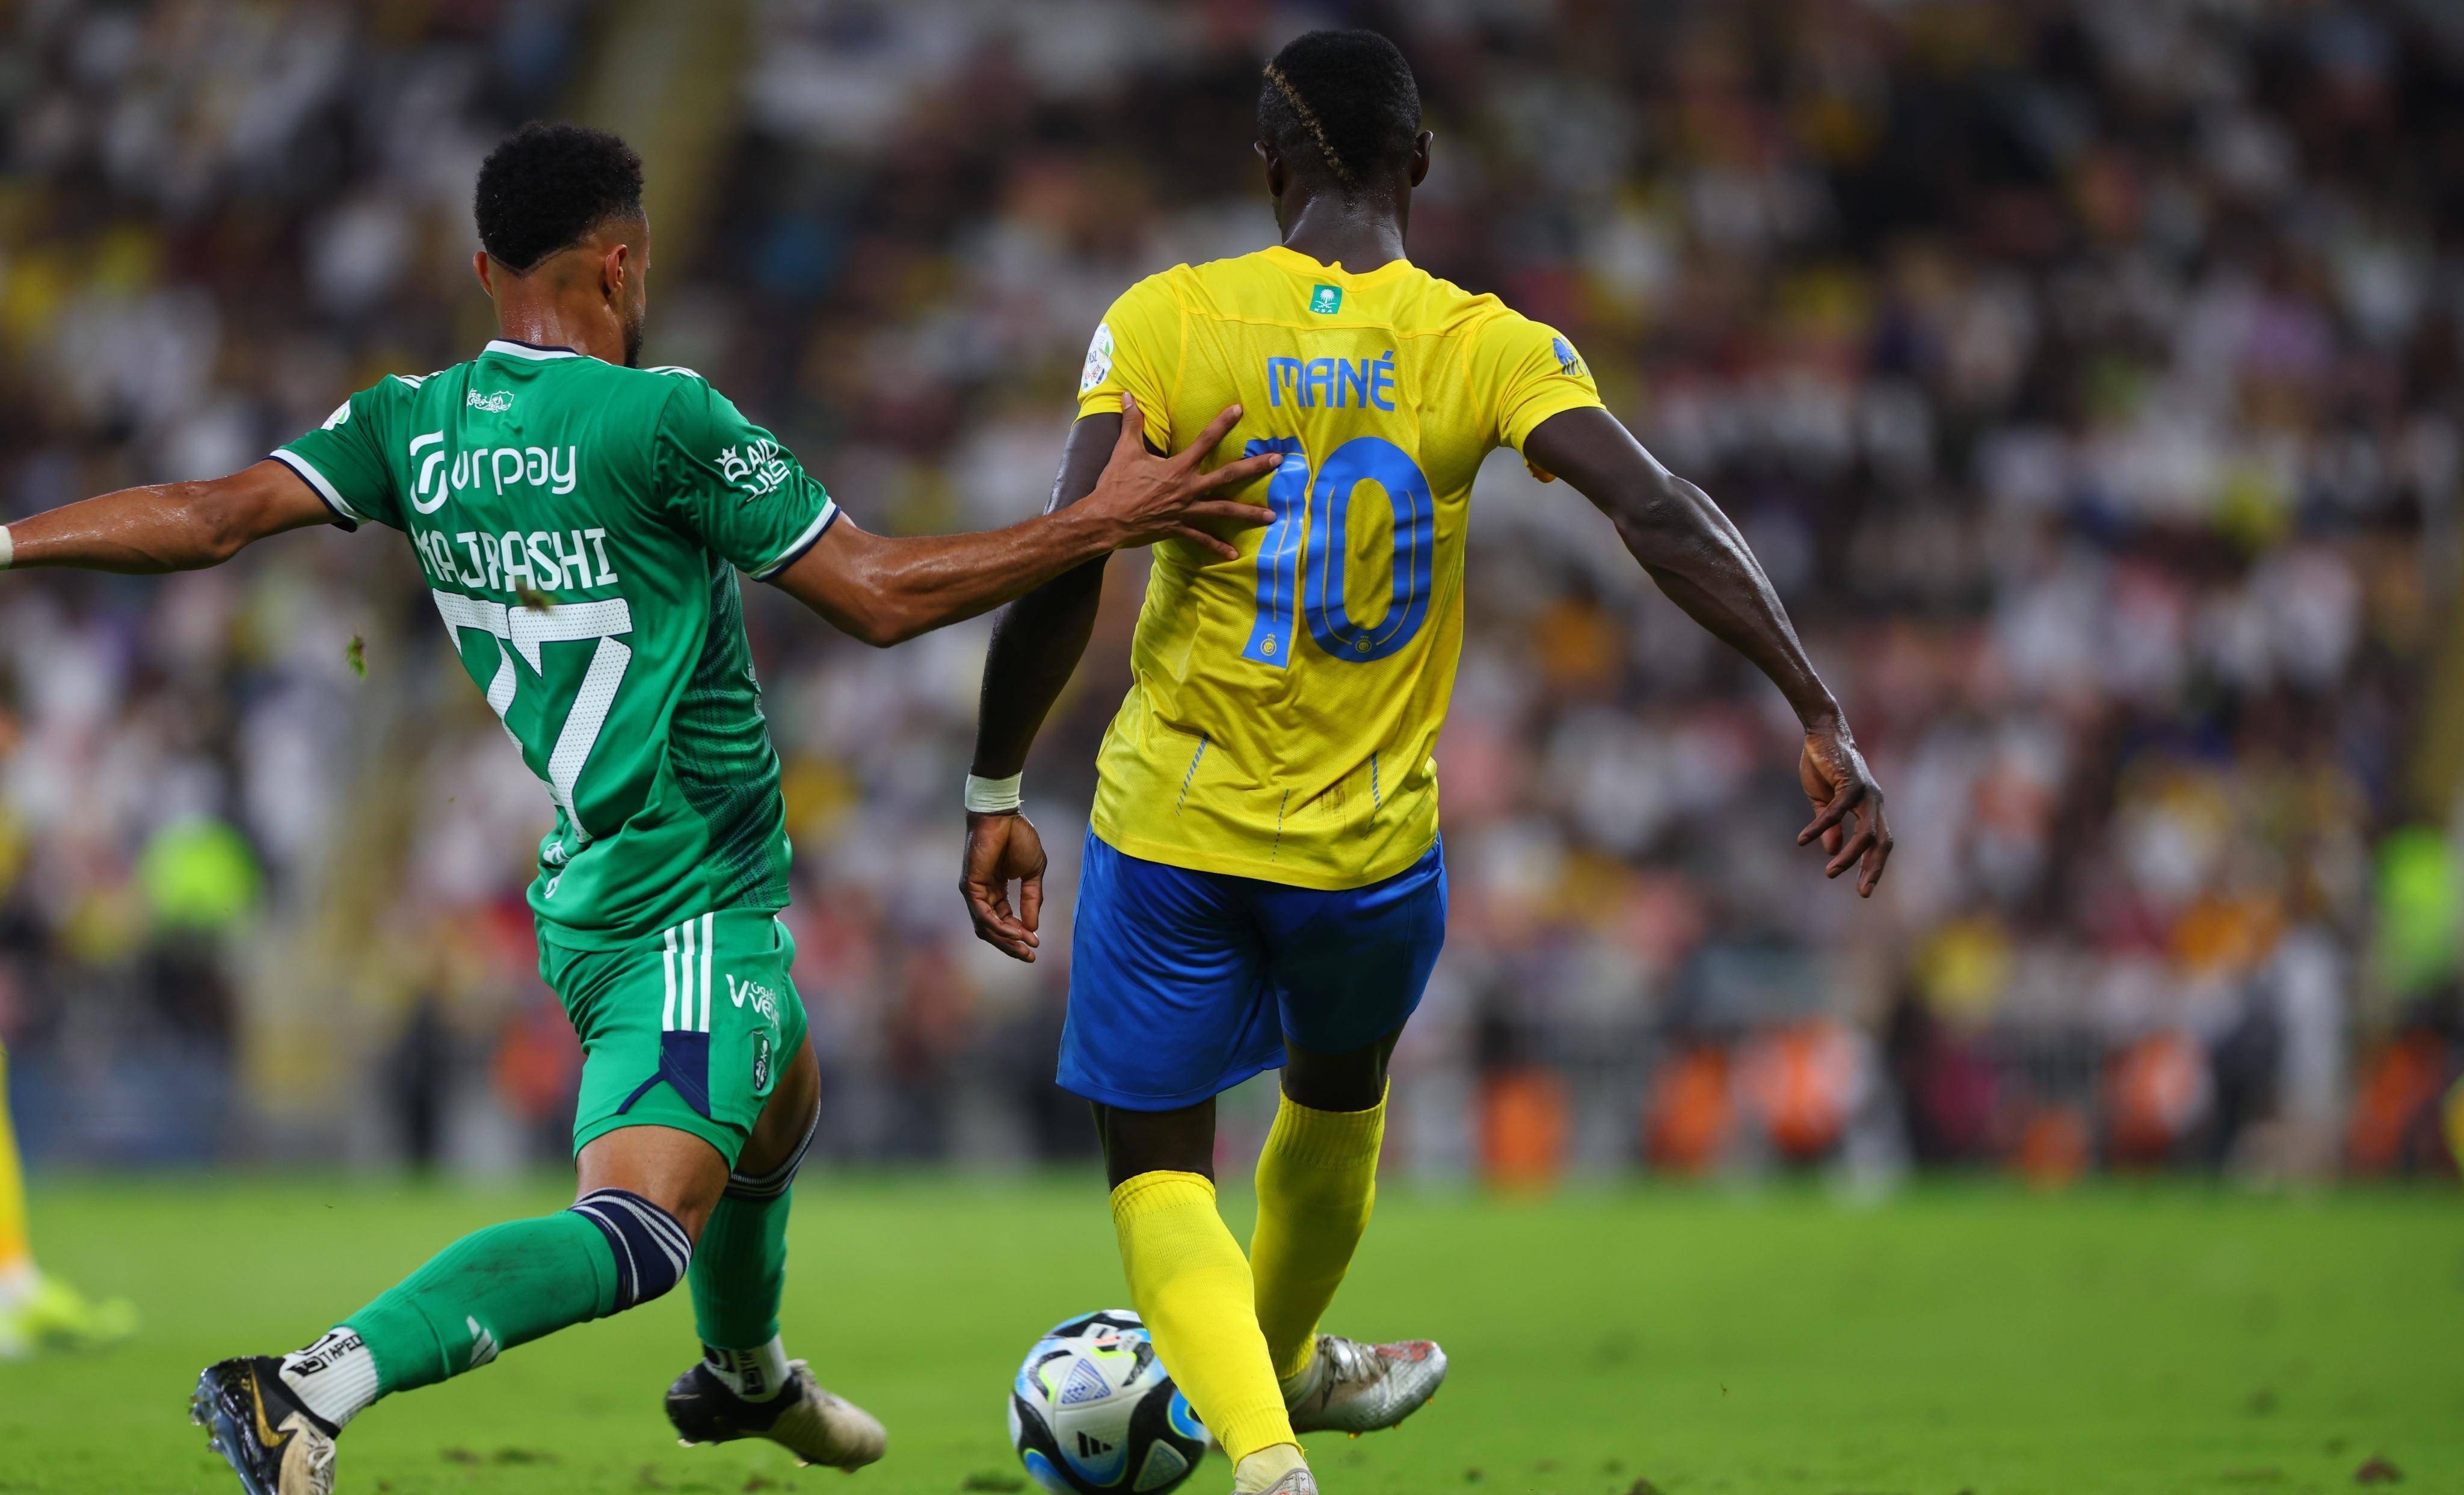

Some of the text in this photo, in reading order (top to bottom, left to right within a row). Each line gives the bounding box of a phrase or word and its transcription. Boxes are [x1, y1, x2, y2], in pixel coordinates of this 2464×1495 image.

[1267, 350, 1396, 412] MANÉ
[724, 438, 780, 482] QAID
[1242, 436, 1434, 669] 10
[432, 587, 633, 843] 77
